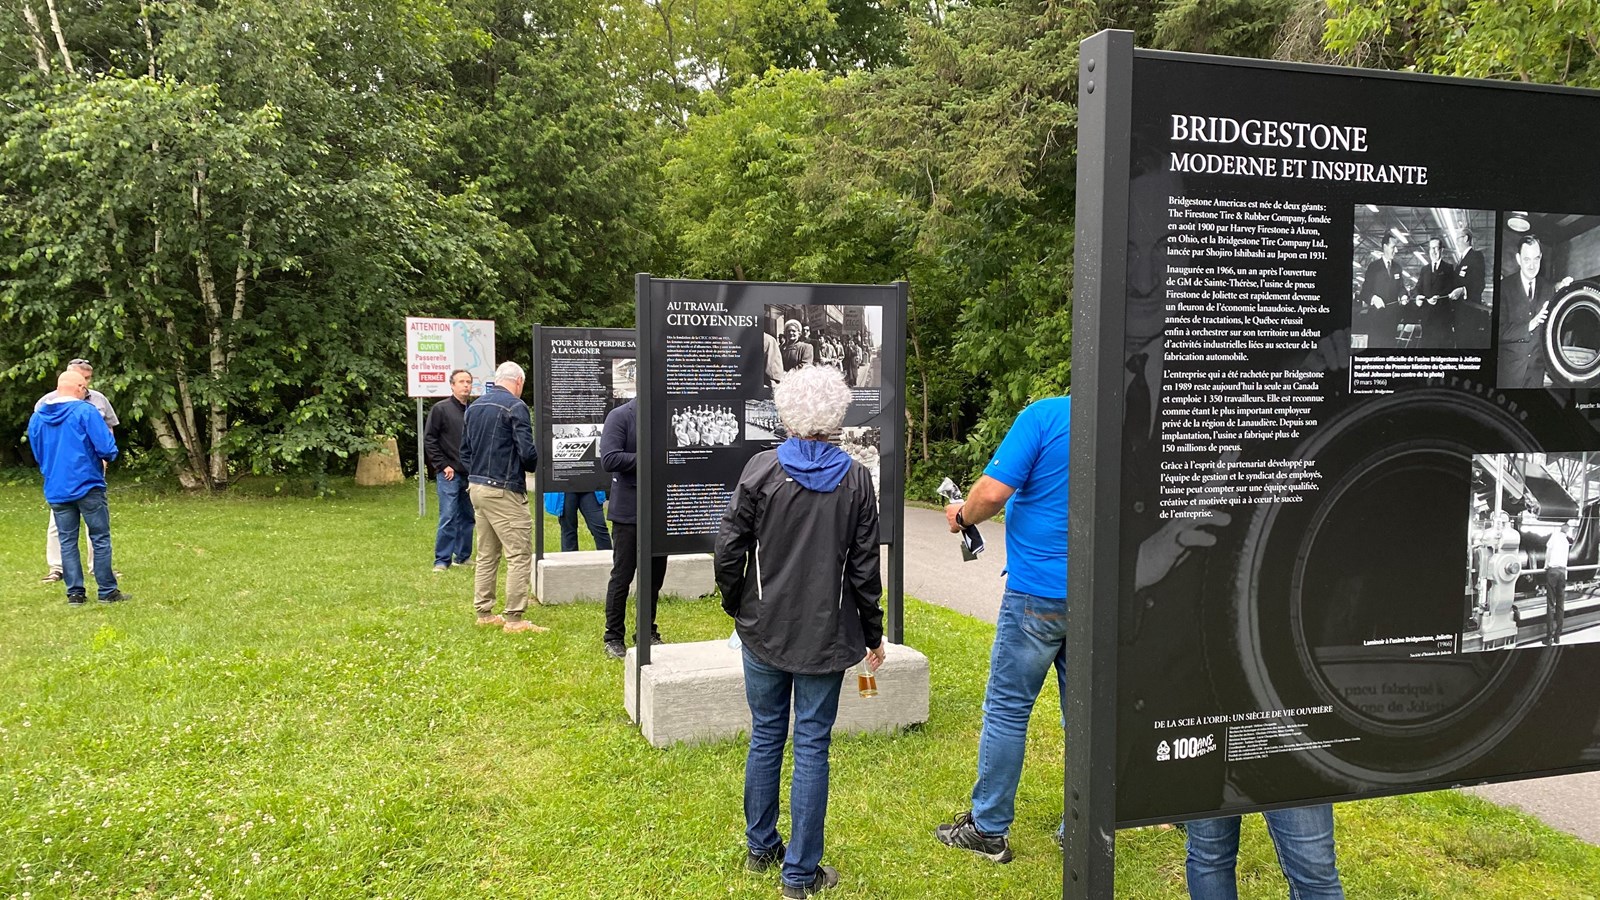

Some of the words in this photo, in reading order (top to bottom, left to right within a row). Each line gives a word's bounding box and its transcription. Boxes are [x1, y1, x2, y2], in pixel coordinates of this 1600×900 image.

[1171, 115, 1368, 152] BRIDGESTONE
[1169, 153, 1277, 177] MODERNE
[1281, 159, 1307, 178] ET
[1311, 160, 1428, 185] INSPIRANTE
[1168, 196, 1213, 208] Bridgestone
[1213, 198, 1247, 207] Americas
[1273, 200, 1282, 208] de
[1283, 201, 1300, 209] deux
[1168, 208, 1184, 217] The
[1185, 209, 1219, 219] Firestone
[1219, 211, 1235, 219] Tire
[1236, 212, 1243, 220] &
[1244, 212, 1270, 221] Rubber
[1271, 213, 1307, 225] Company,
[1308, 214, 1332, 223] fondée
[1178, 222, 1196, 231] août
[1198, 223, 1215, 231] 1900
[1216, 226, 1229, 234] par
[1230, 224, 1256, 235] Harvey
[1257, 225, 1290, 234] Firestone
[1290, 226, 1295, 234] à
[1296, 226, 1320, 236] Akron,
[1178, 234, 1200, 244] Ohio,
[1200, 236, 1208, 244] et
[1209, 235, 1216, 244] la
[1218, 236, 1260, 247] Bridgestone
[1261, 237, 1276, 246] Tire
[1277, 238, 1311, 249] Company
[1312, 239, 1328, 249] Ltd.,
[1167, 246, 1191, 256] lancée
[1192, 250, 1205, 258] par
[1206, 247, 1233, 259] Shojiro
[1234, 248, 1266, 258] Ishibashi
[1277, 250, 1298, 261] Japon
[1310, 252, 1328, 260] 1931.
[667, 302, 682, 311] AU
[683, 302, 728, 313] TRAVAIL,
[411, 322, 450, 331] ATTENTION
[421, 373, 444, 381] FERMÉE
[1160, 461, 1183, 469] Grâce
[1184, 461, 1189, 469] à
[1216, 460, 1226, 468] de
[1227, 459, 1266, 471] partenariat
[1267, 458, 1303, 469] développé
[1303, 461, 1316, 469] par
[1191, 472, 1201, 481] de
[1202, 472, 1228, 483] gestion
[1238, 471, 1245, 480] le
[1246, 471, 1275, 482] syndicat
[1276, 470, 1288, 479] des
[1289, 470, 1323, 481] employés,
[1186, 486, 1203, 496] peut
[1204, 486, 1235, 495] compter
[1263, 482, 1288, 494] équipe
[1288, 481, 1320, 493] qualifiée,
[1159, 497, 1189, 506] créative
[1198, 496, 1228, 505] motivée
[1228, 498, 1241, 506] qui
[1248, 496, 1253, 504] à
[1273, 494, 1281, 503] le
[1281, 494, 1303, 503] succès
[1159, 510, 1169, 518] de
[1154, 721, 1166, 729] DE
[1167, 720, 1177, 728] LA
[1178, 718, 1195, 727] SCIE
[1196, 717, 1202, 725] À
[1232, 713, 1245, 722] UN
[1246, 711, 1271, 720] SIÈCLE
[1271, 710, 1282, 718] DE
[1282, 709, 1296, 717] VIE
[1296, 705, 1333, 716] OUVRIÈRE
[1173, 737, 1198, 759] 100
